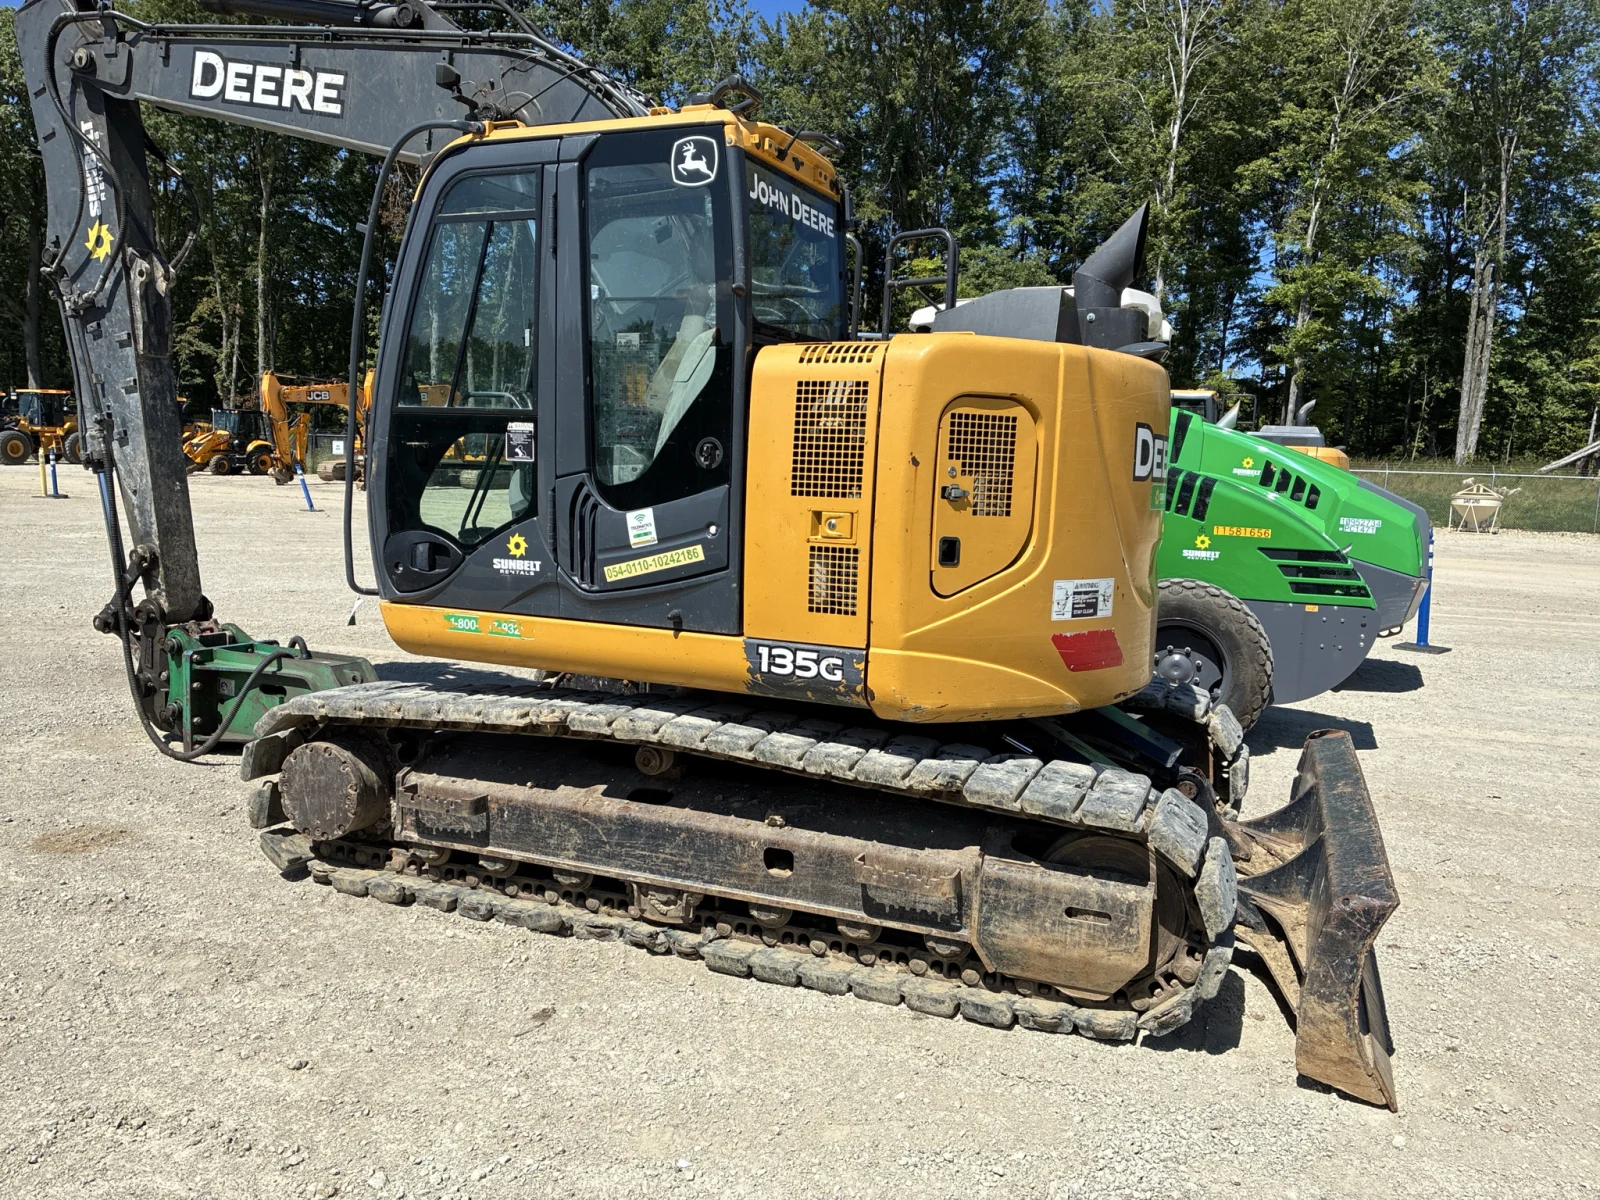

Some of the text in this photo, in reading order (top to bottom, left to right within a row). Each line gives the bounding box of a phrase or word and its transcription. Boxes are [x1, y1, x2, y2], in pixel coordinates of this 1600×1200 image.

[192, 51, 345, 114] DEERE
[95, 131, 106, 201] RENTLS
[750, 173, 835, 238] JOHN DEERE
[306, 391, 330, 400] JCB
[1341, 518, 1381, 527] 10952734
[1344, 525, 1376, 533] PC1471
[1215, 526, 1270, 538] 11581656
[1182, 549, 1220, 558] SUNBELT
[493, 558, 541, 571] SUNBELT
[606, 548, 700, 579] 054-0110-10242186
[758, 646, 843, 682] 135G
